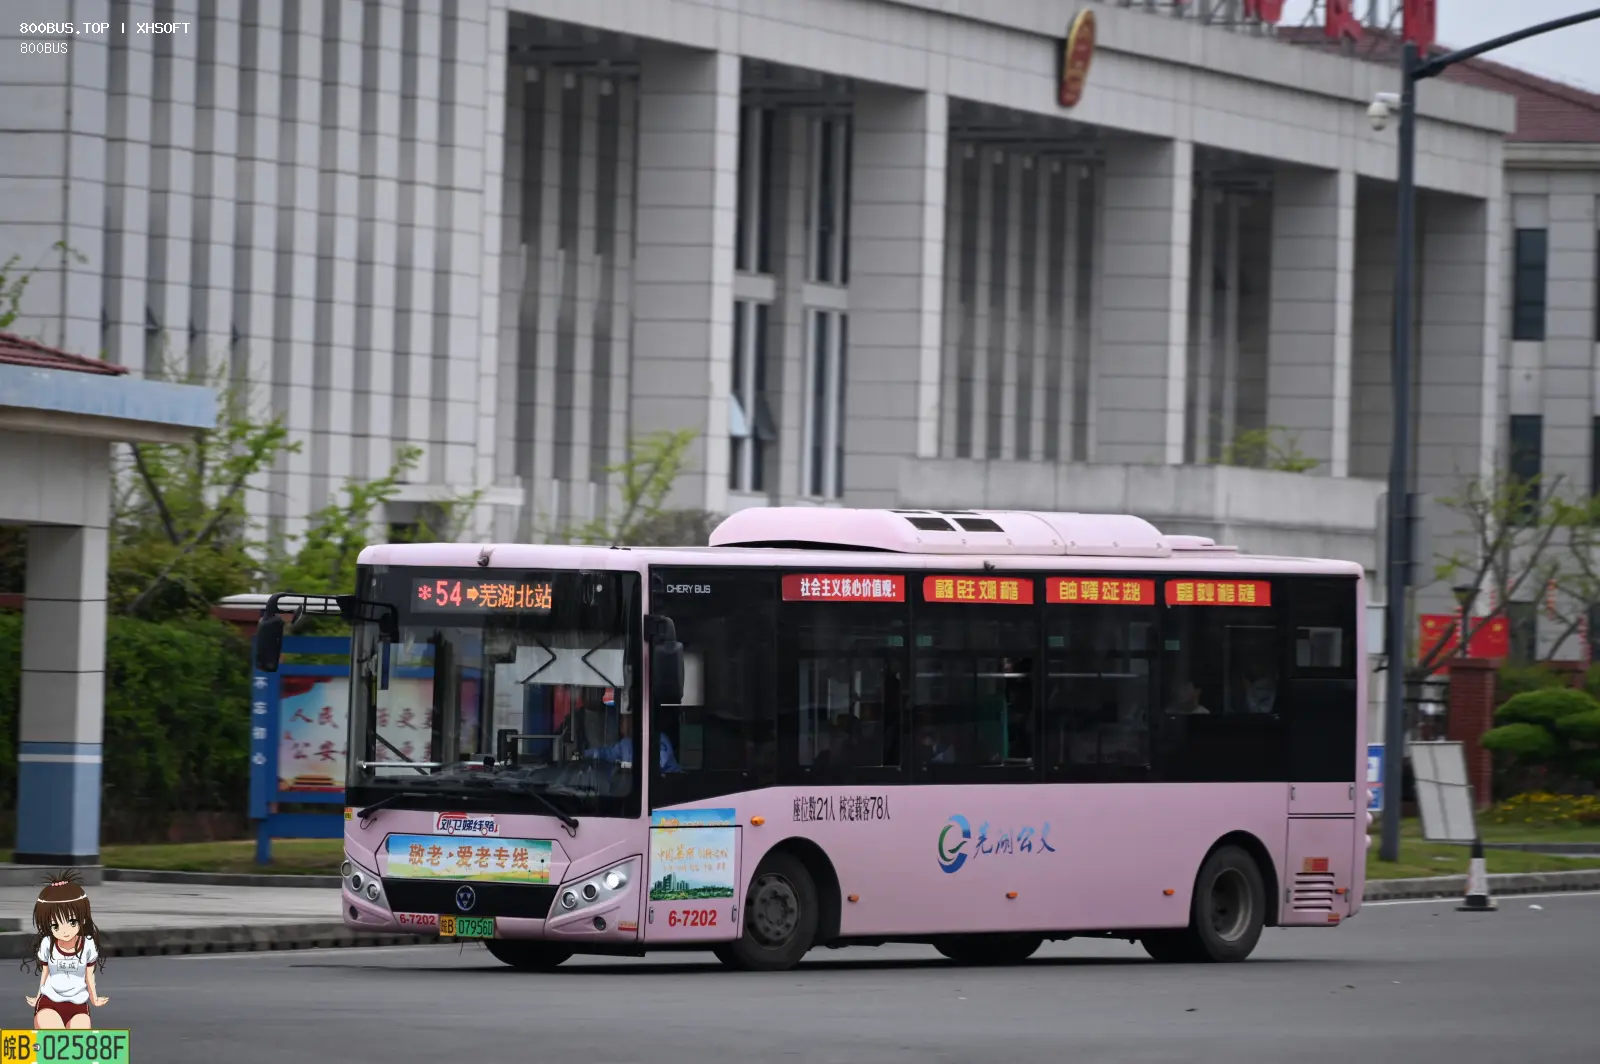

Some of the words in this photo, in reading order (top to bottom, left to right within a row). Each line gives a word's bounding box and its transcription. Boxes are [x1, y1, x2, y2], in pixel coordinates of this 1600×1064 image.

[435, 580, 462, 607] 54
[478, 583, 552, 609] 芜湖北站
[666, 584, 693, 594] CHERY
[694, 584, 711, 594] BUS
[792, 796, 836, 822] 座位数21人
[838, 795, 890, 822] 核定载客78人
[400, 913, 437, 926] 6-7202
[668, 909, 717, 927] 6-7202
